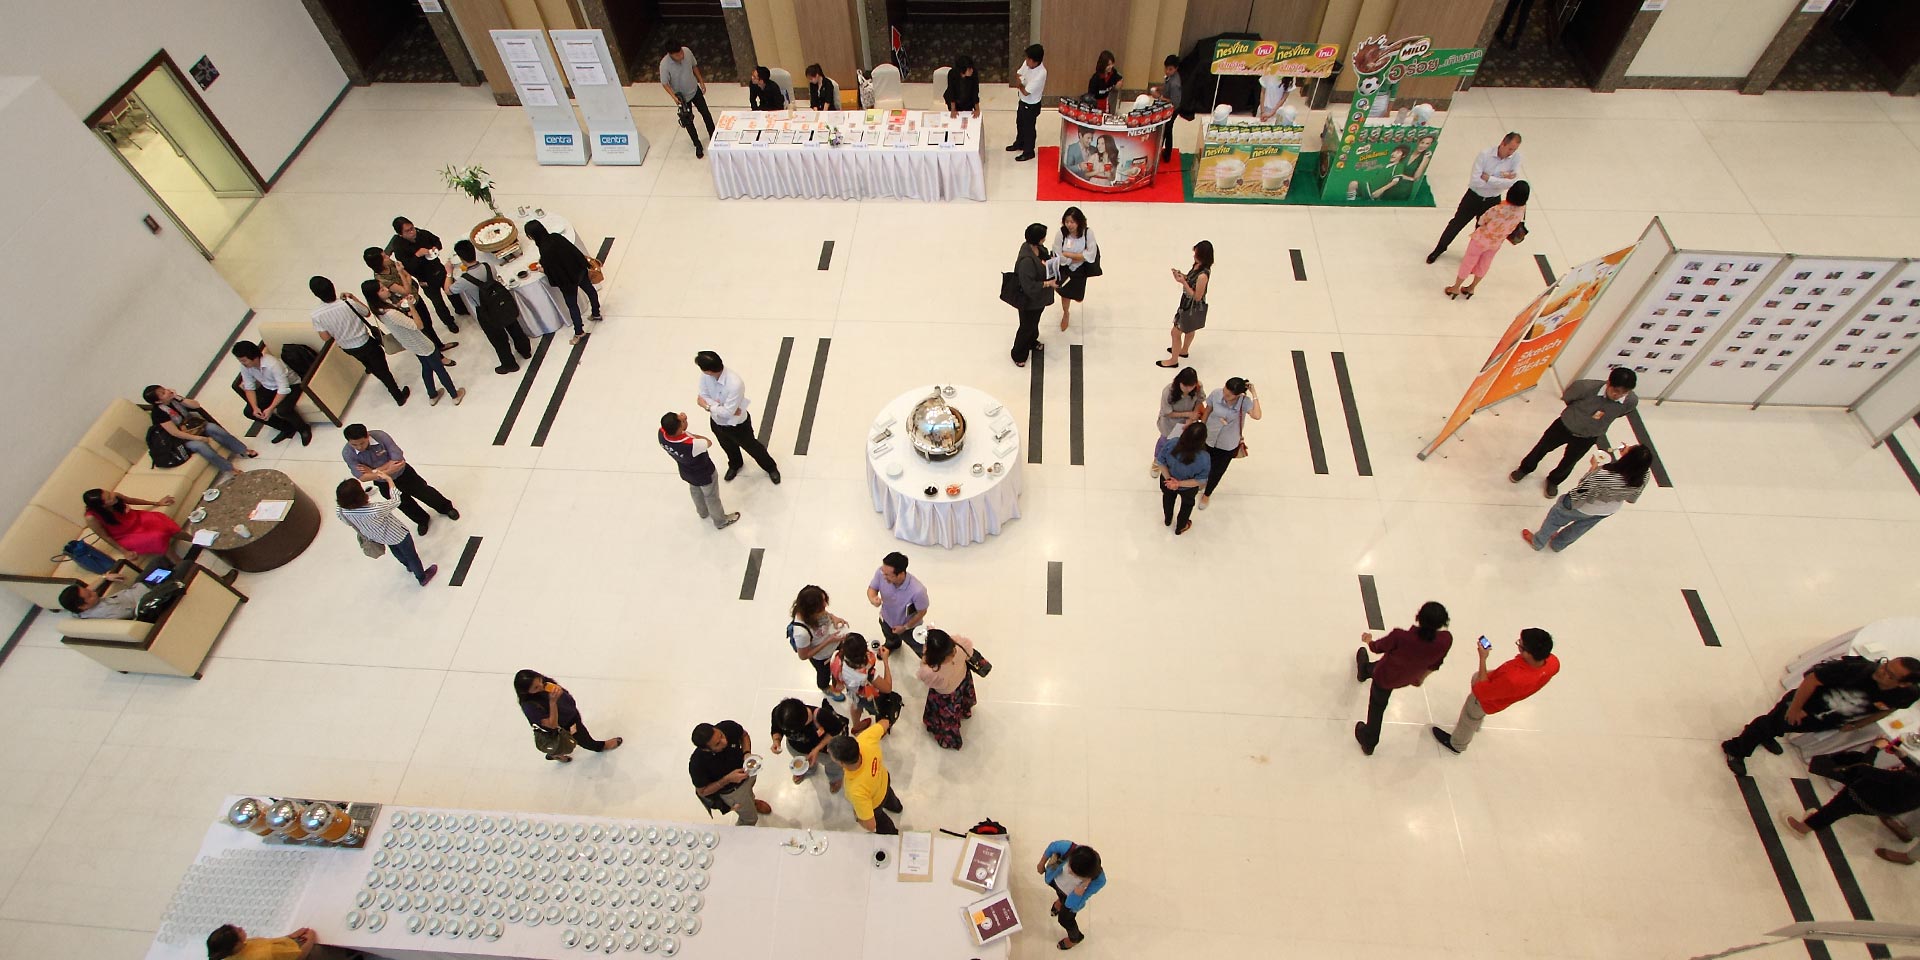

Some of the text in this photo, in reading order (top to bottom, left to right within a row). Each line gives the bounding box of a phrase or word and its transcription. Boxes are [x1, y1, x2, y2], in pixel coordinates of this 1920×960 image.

[1400, 44, 1428, 57] MILO
[546, 135, 572, 144] centra
[601, 135, 628, 144] centra
